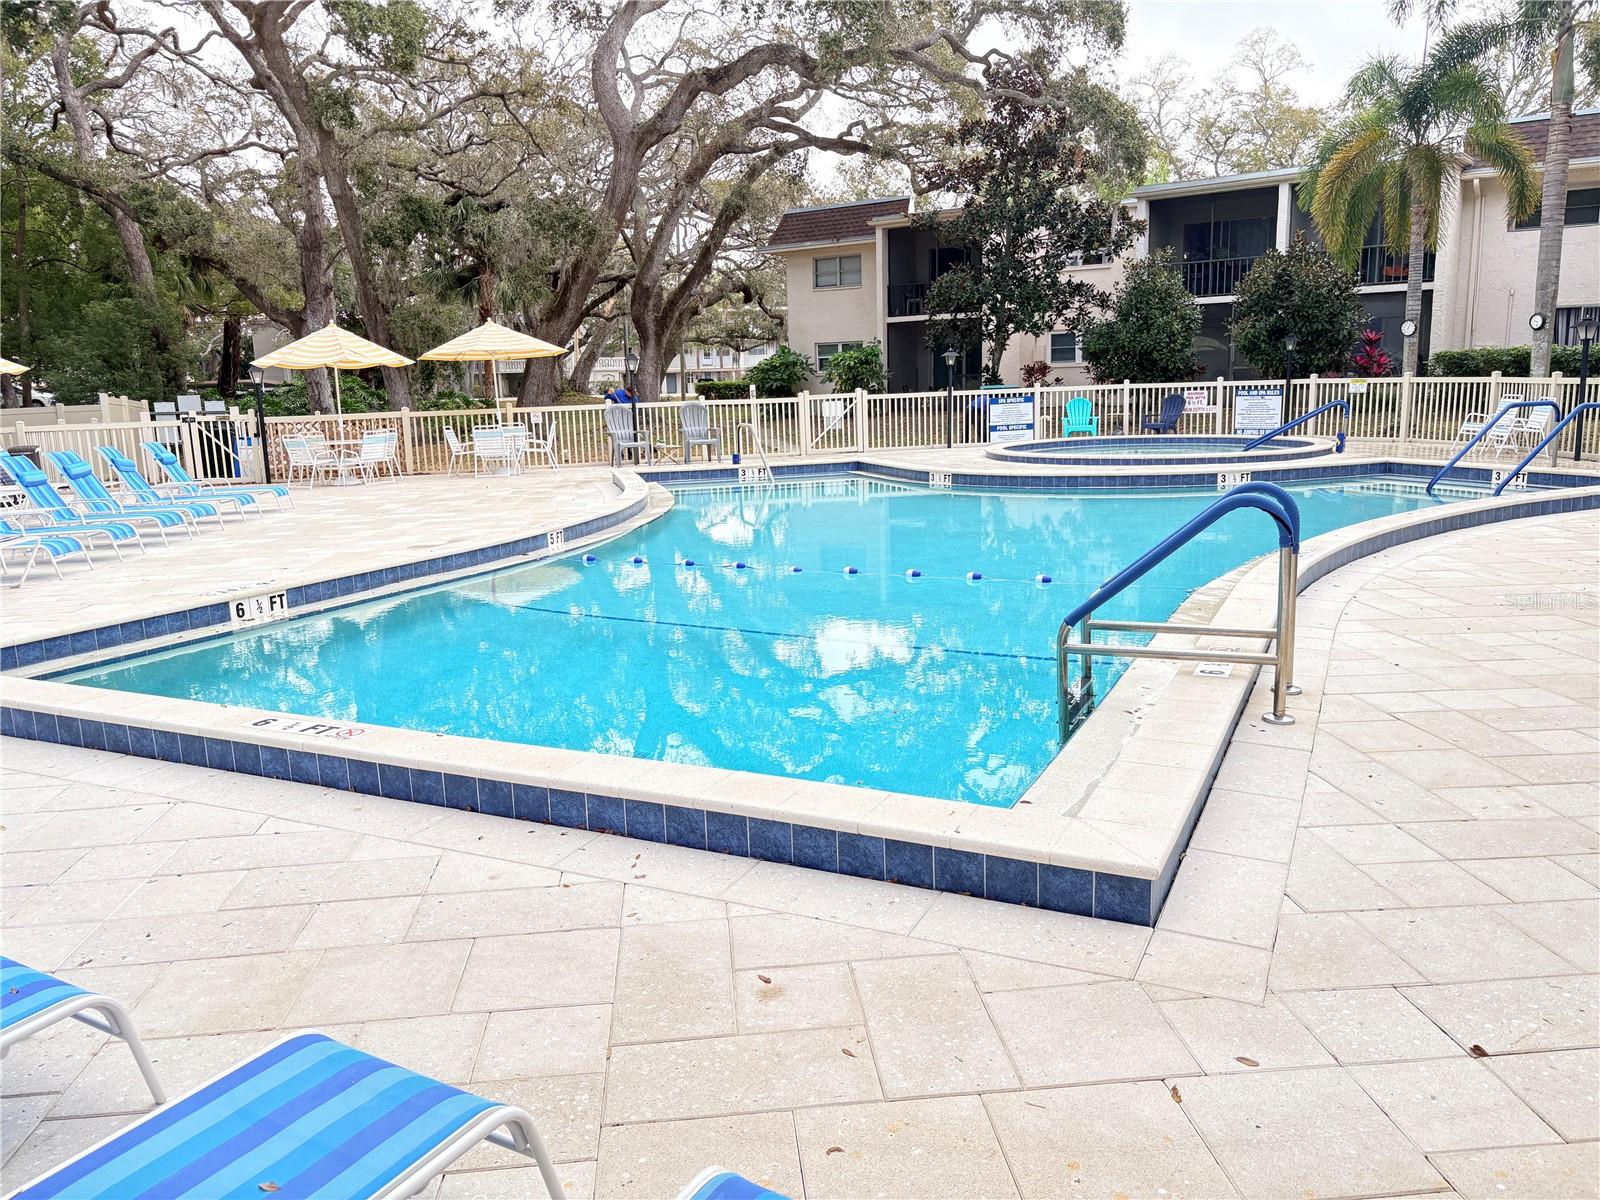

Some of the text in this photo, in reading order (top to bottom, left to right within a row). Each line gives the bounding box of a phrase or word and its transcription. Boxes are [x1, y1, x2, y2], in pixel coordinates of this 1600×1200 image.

[741, 469, 746, 477] 3
[757, 467, 766, 476] FT
[930, 473, 935, 482] 3
[943, 473, 952, 483] FT
[1220, 473, 1227, 483] 3
[1240, 472, 1250, 482] FT
[1494, 471, 1527, 483] 3 FT
[549, 530, 563, 545] 5 FT
[235, 602, 246, 618] 6
[269, 593, 285, 612] FT
[252, 718, 279, 727] 6
[299, 724, 341, 735] FT
